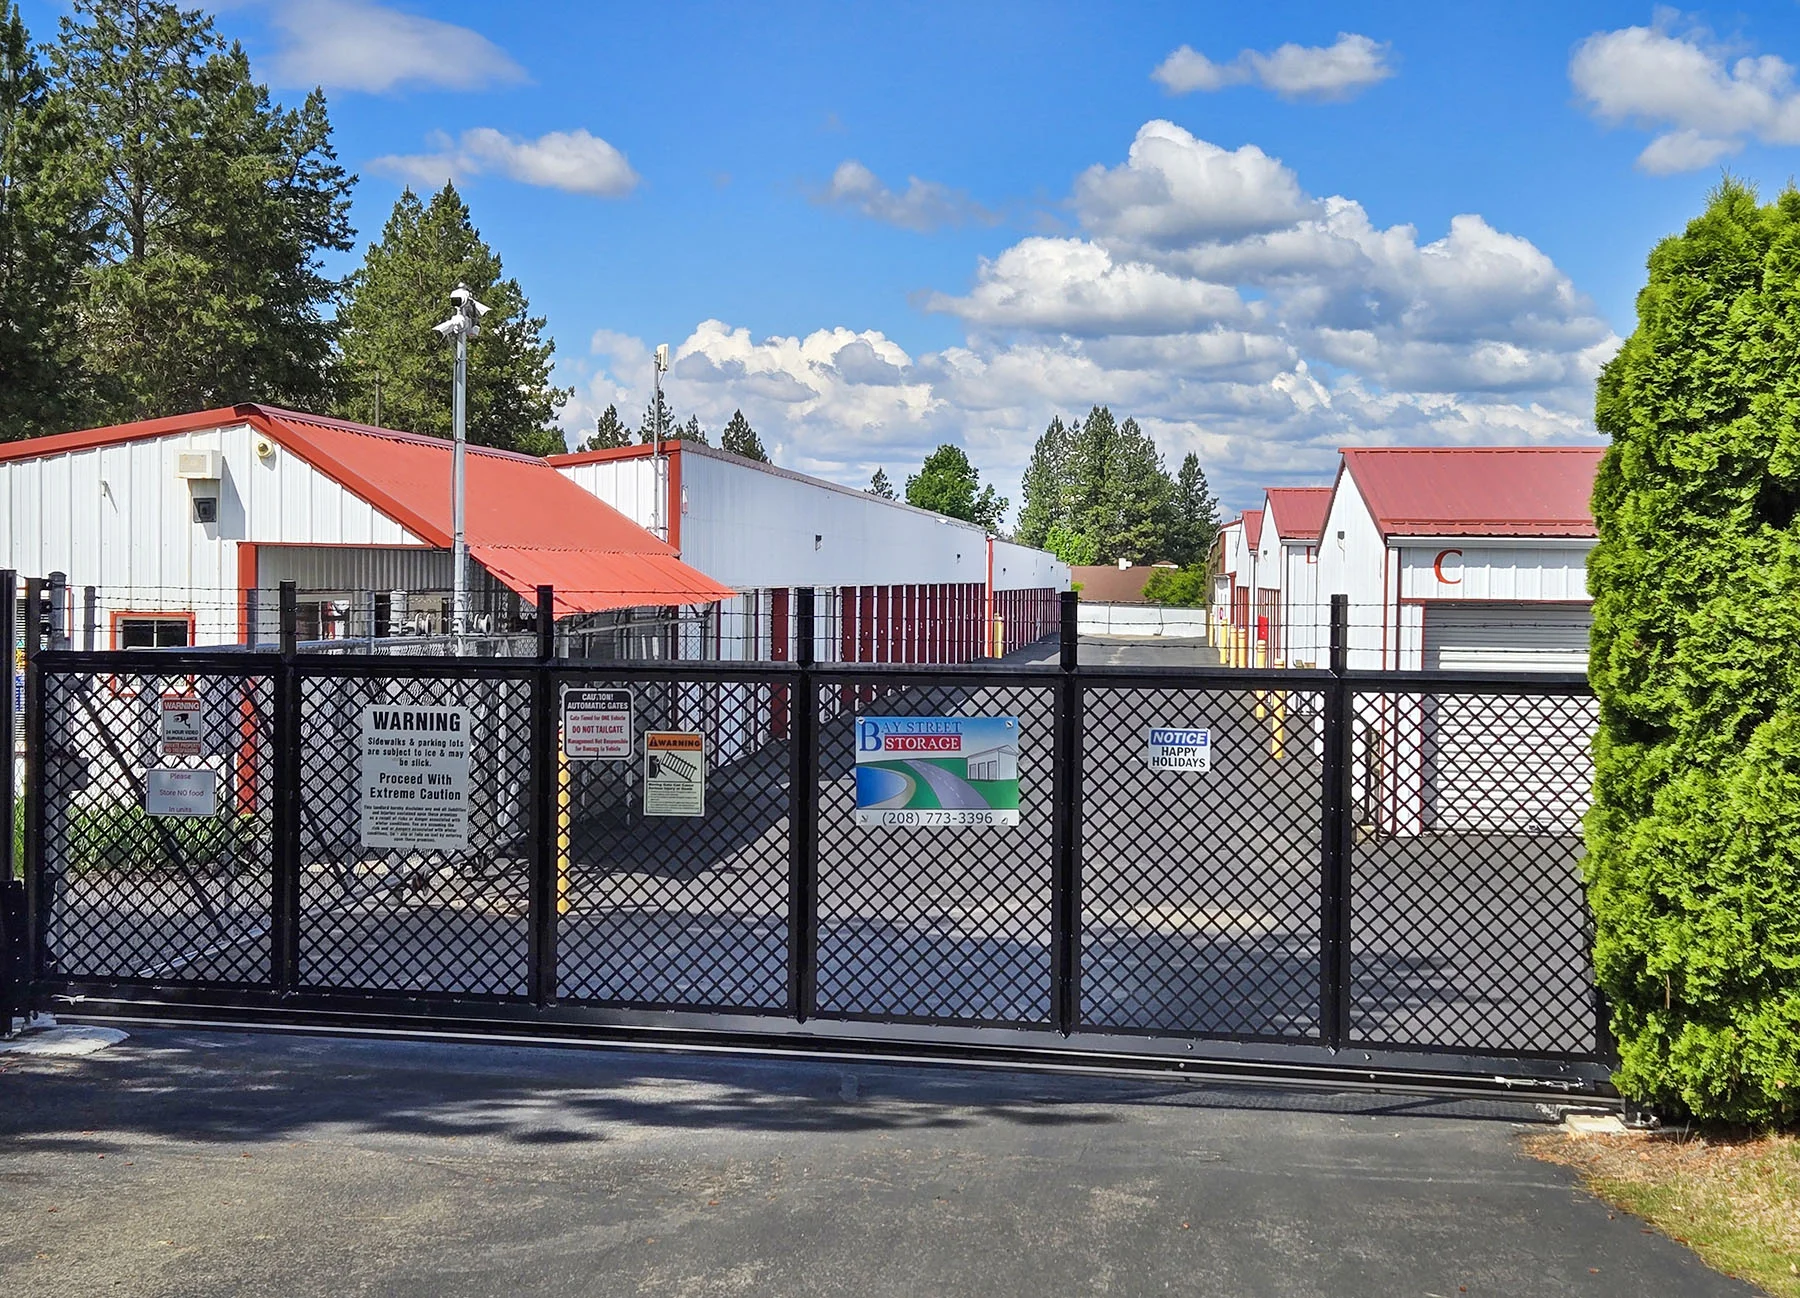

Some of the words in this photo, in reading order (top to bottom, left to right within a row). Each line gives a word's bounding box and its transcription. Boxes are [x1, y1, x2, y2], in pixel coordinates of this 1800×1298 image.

[1433, 548, 1463, 585] C
[164, 701, 200, 710] WARNING
[567, 702, 606, 710] AUTOMATIC
[608, 702, 628, 710] GATES
[373, 711, 461, 731] WARNING
[572, 725, 581, 733] DO
[582, 725, 594, 733] NOT
[596, 725, 624, 733] TAILGATE
[859, 721, 905, 751] BAY
[907, 721, 963, 733] STREET
[1152, 731, 1207, 744] NOTICE
[368, 737, 406, 746] Sidewalks
[409, 738, 415, 746] &
[418, 739, 446, 748] parking
[449, 739, 464, 747] lots
[659, 739, 700, 747] WARNING
[885, 737, 960, 750] STORAGE
[383, 748, 411, 757] subject
[425, 749, 436, 757] ice
[448, 751, 464, 759] may
[1161, 746, 1198, 757] HAPPY
[411, 759, 432, 767] slick.
[1152, 756, 1206, 768] HOLIDAYS
[380, 773, 423, 784] Proceed
[428, 774, 452, 785] With
[370, 787, 416, 799] Extreme
[420, 788, 461, 800] Caution
[882, 811, 920, 826] (208)
[926, 812, 993, 824] 773-3396
